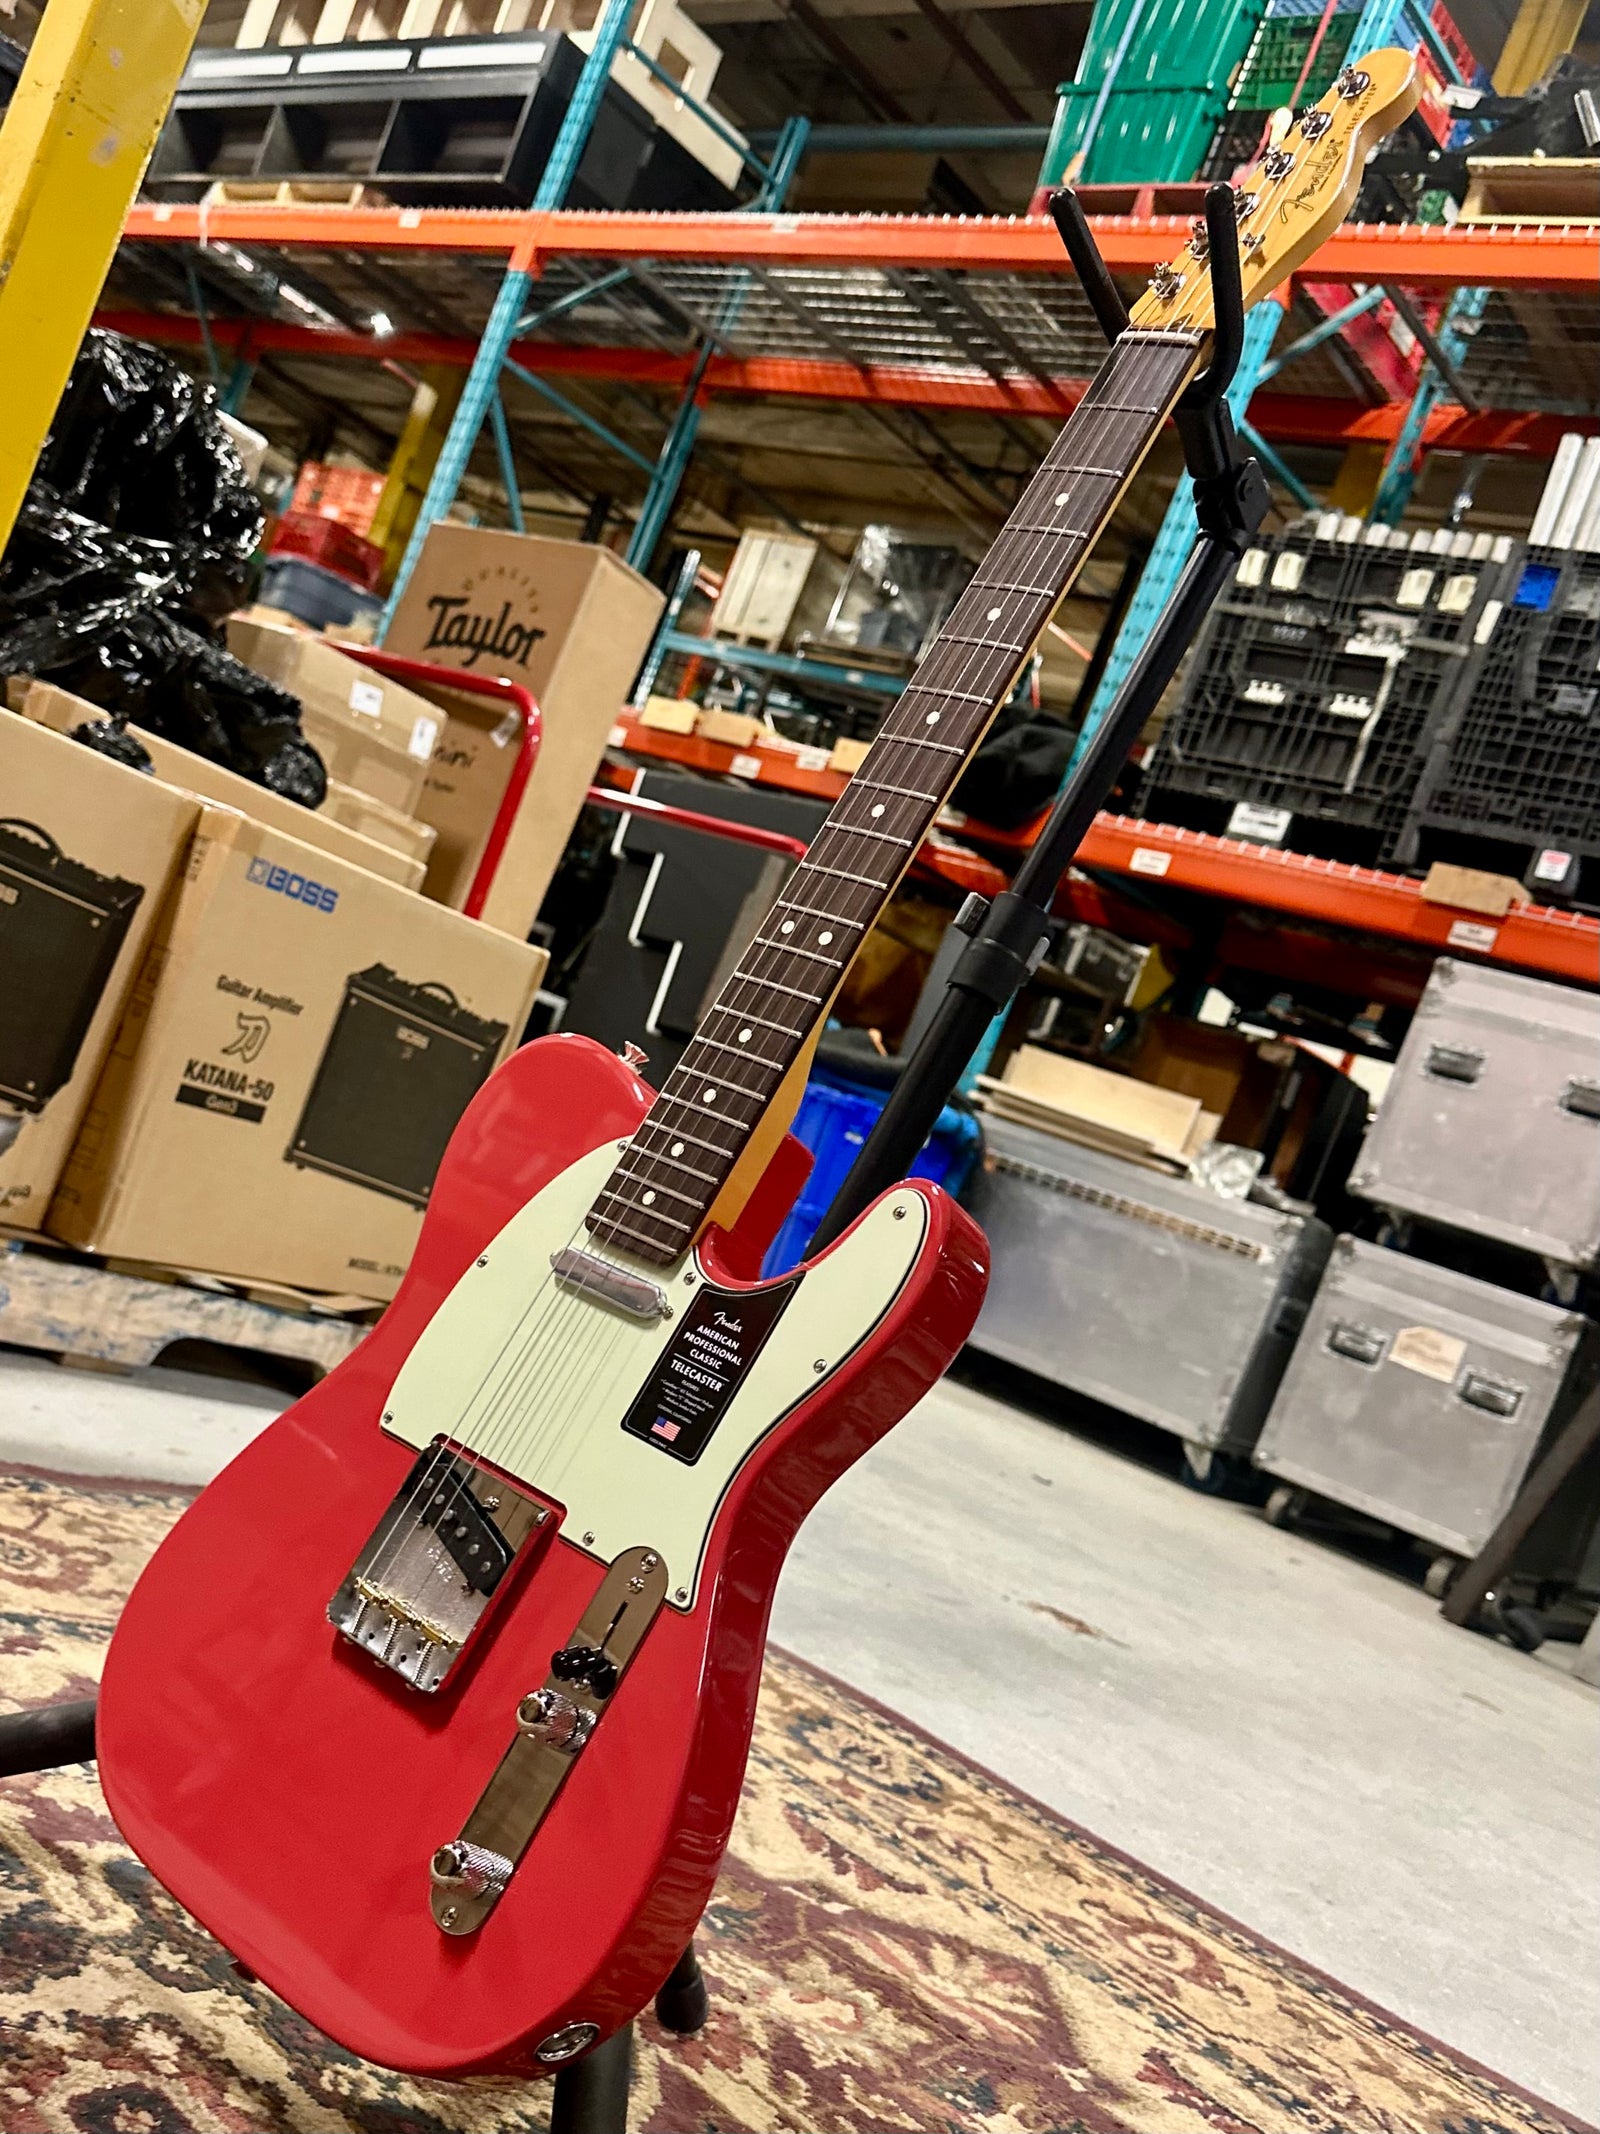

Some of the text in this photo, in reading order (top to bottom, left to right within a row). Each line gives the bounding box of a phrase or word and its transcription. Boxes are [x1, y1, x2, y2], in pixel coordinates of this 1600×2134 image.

[1279, 138, 1344, 224] Fender
[427, 595, 547, 667] Taylor
[265, 865, 340, 914] BOSS
[216, 974, 304, 1016] Guitar Amplifier
[183, 1058, 276, 1101] KATANA-50
[696, 1325, 740, 1350] AMERICAN
[713, 1311, 743, 1333] Fender
[683, 1331, 743, 1366] PROFESSIONAL
[689, 1348, 722, 1370] CLASSIC
[670, 1359, 724, 1392] TELECASTER
